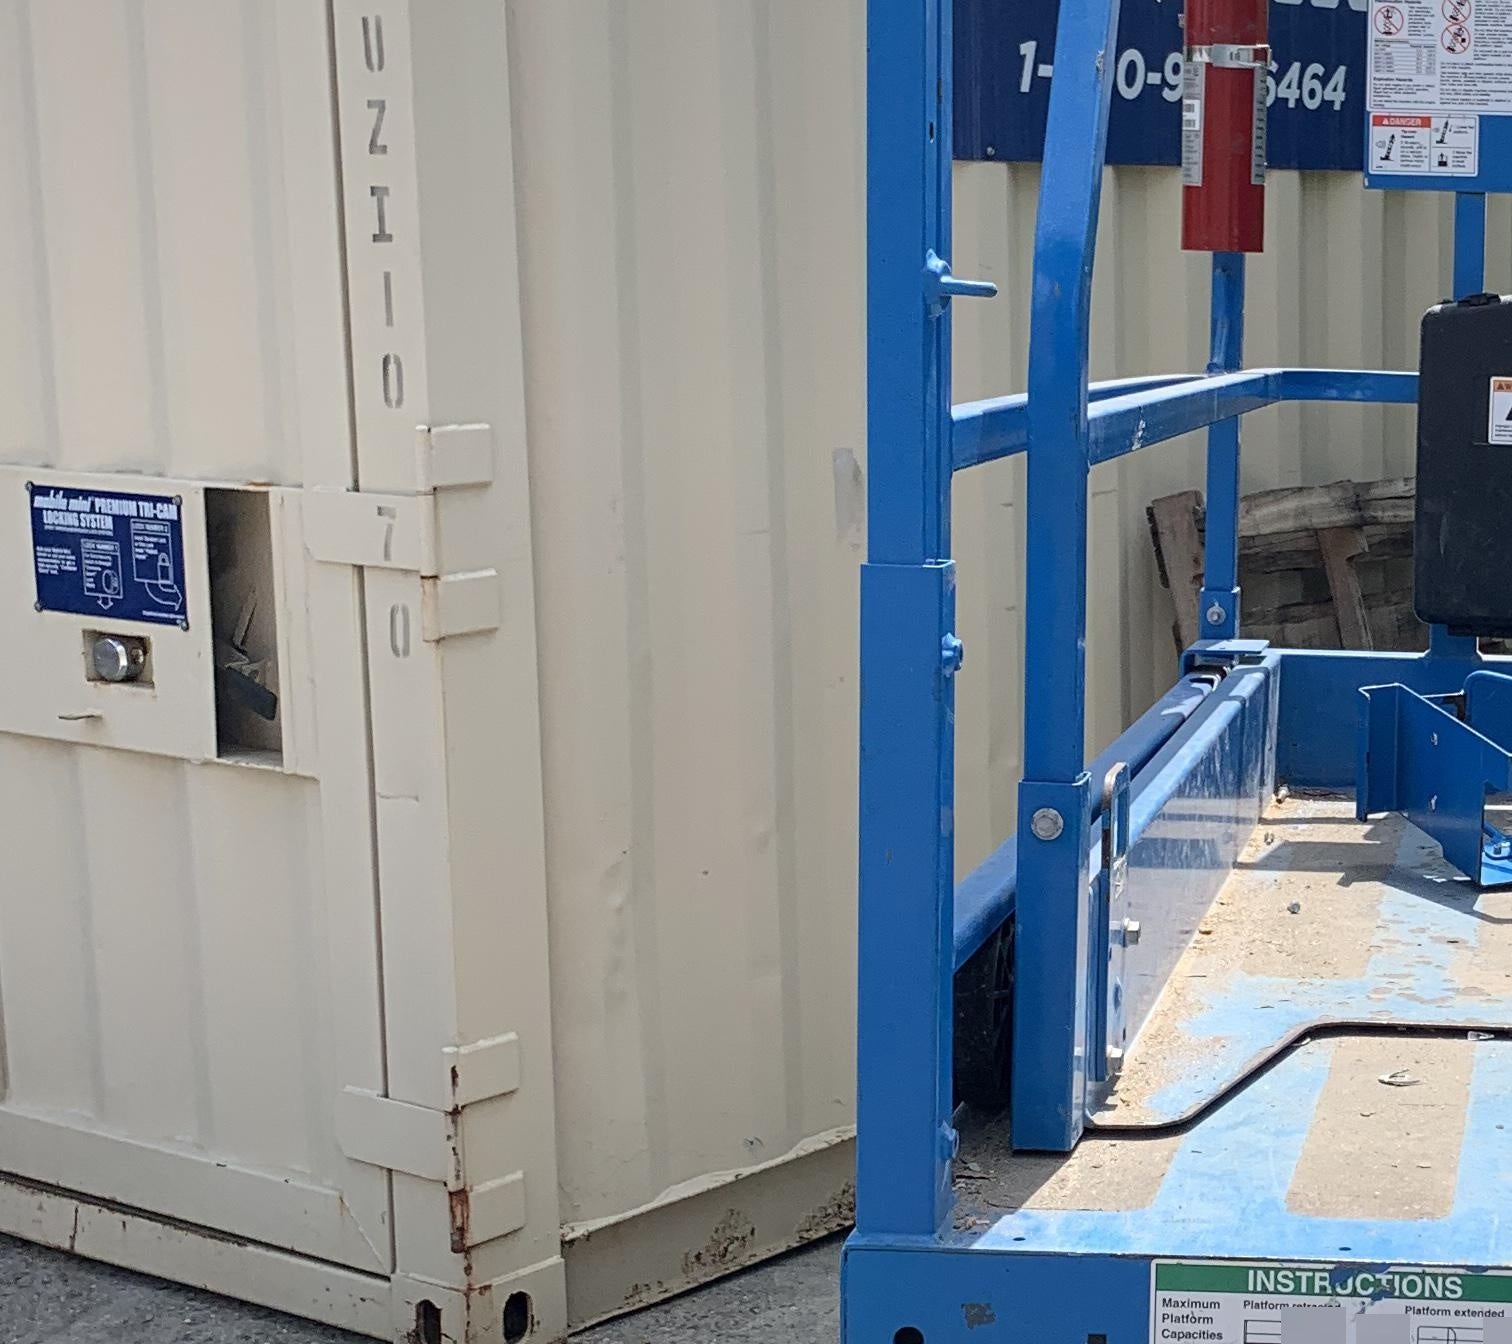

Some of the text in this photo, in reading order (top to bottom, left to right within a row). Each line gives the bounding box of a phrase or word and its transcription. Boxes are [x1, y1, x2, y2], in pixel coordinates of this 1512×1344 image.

[1389, 117, 1421, 125] DANGER
[94, 497, 137, 517] PREMIUM
[138, 501, 178, 520] TRI-CAM
[42, 510, 114, 530] LOCKING SYSTEM
[1248, 1269, 1463, 1299] INSTRUCTIONS
[1162, 1298, 1220, 1309] Maximum
[1243, 1300, 1289, 1310] Platform
[1405, 1306, 1505, 1318] Platform extended
[1162, 1313, 1213, 1324] Platform
[1161, 1329, 1223, 1341] Capacities
